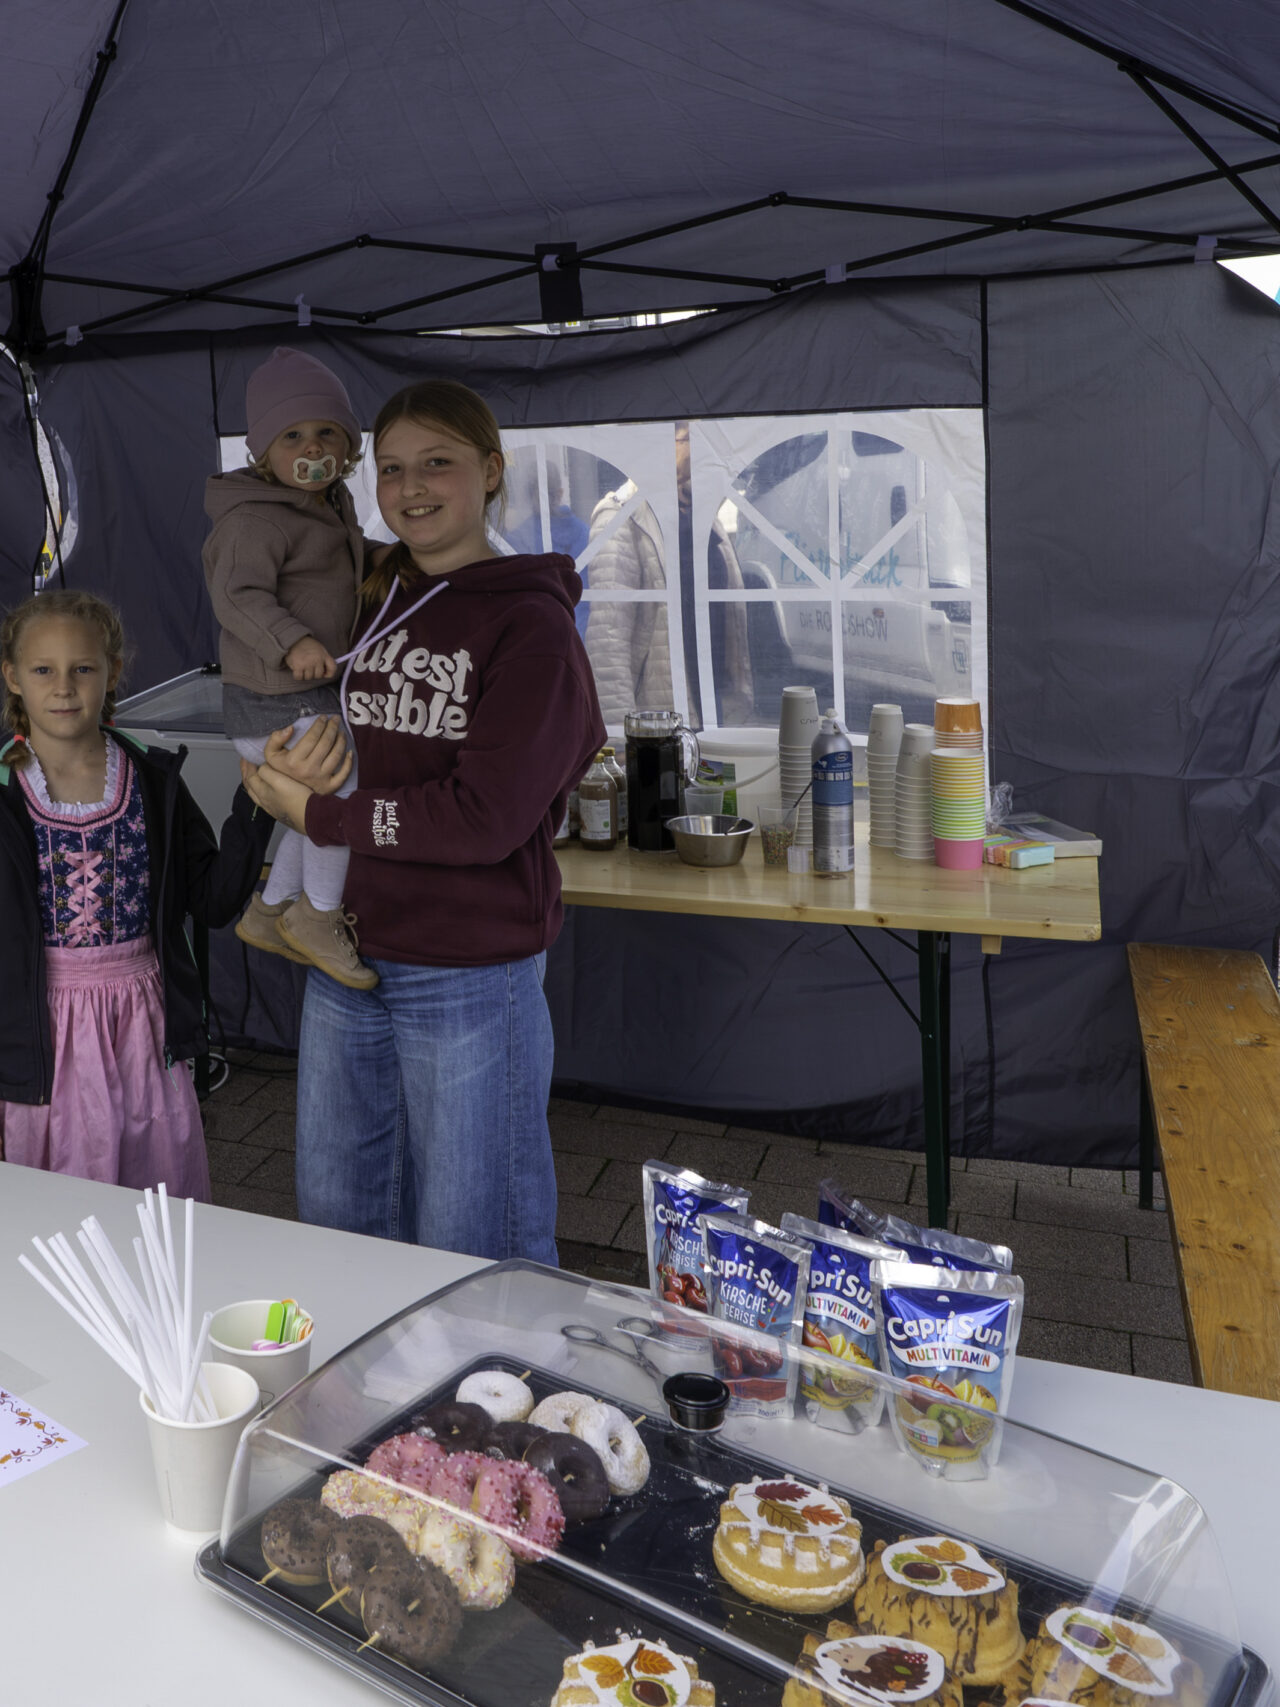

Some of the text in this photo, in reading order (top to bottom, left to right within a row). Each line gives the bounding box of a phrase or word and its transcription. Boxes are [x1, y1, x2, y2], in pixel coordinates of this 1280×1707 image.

[815, 609, 888, 642] ROSHOW
[353, 629, 473, 703] ut est
[347, 681, 469, 740] ssible
[372, 799, 387, 847] possible
[385, 800, 400, 827] tout
[655, 1203, 703, 1236] Capri-S
[709, 1254, 792, 1307] Capri-Sun
[810, 1268, 874, 1310] priSu
[805, 1296, 870, 1331] ULTIVITAMIN
